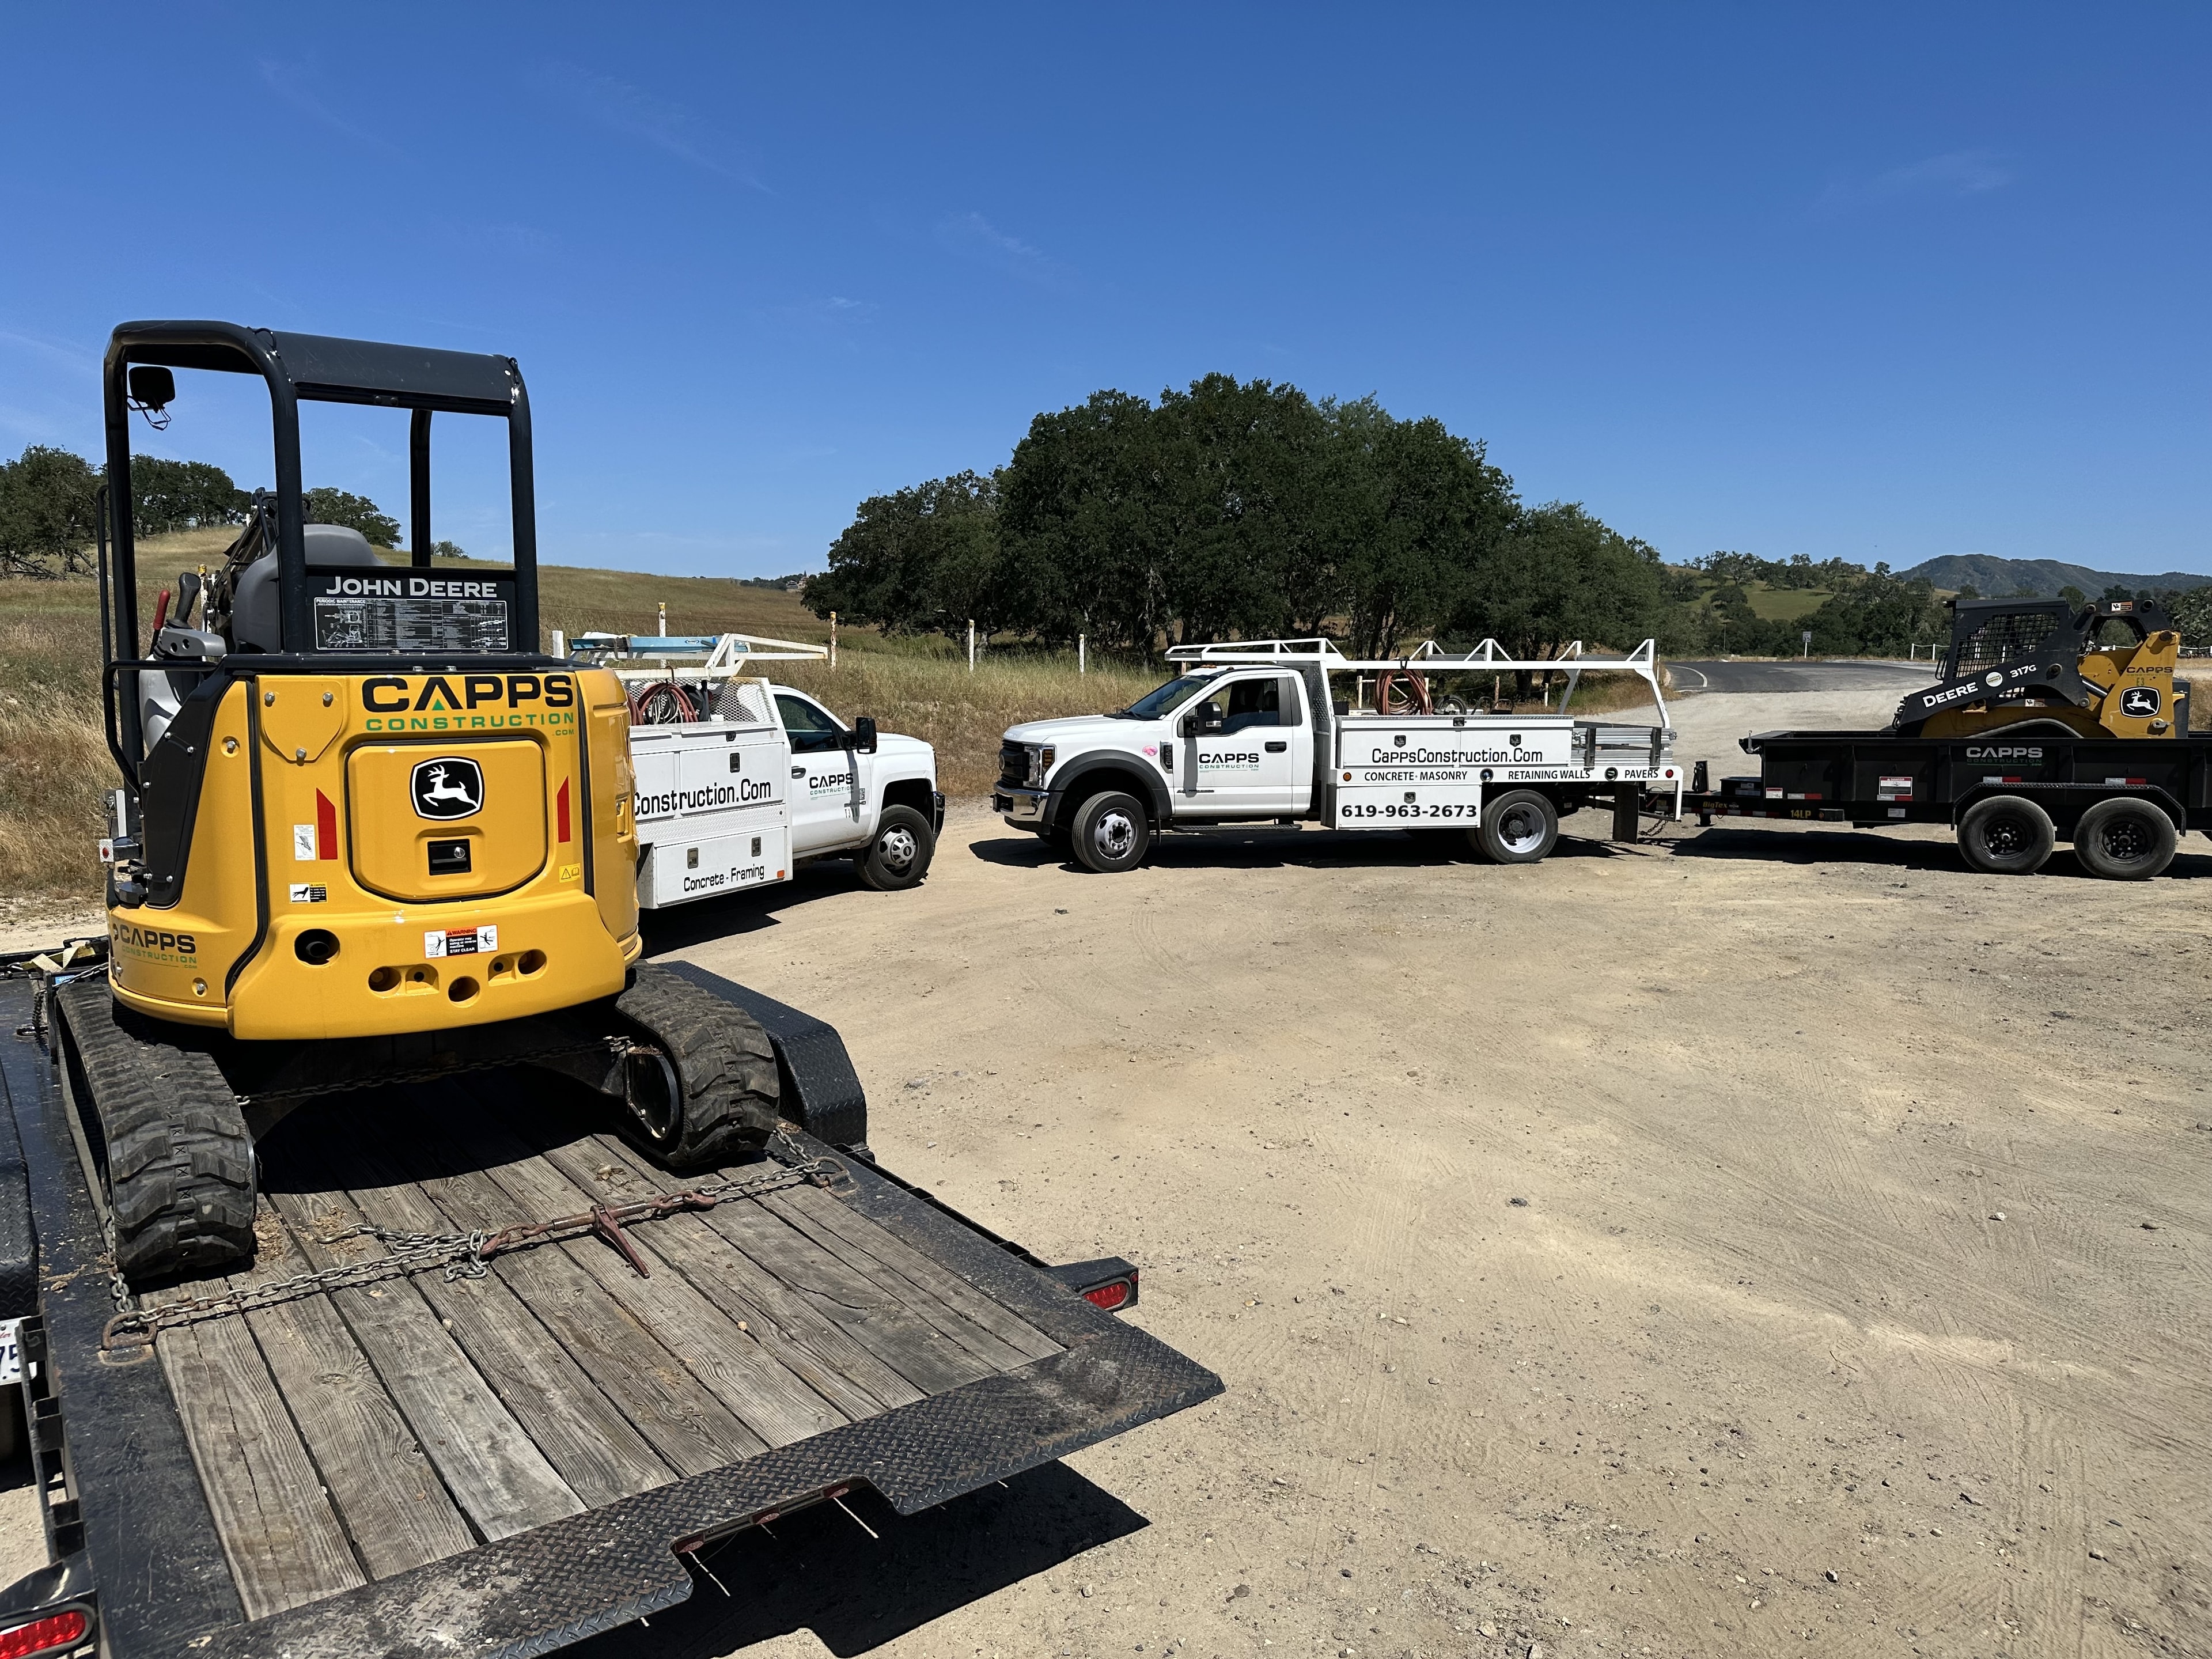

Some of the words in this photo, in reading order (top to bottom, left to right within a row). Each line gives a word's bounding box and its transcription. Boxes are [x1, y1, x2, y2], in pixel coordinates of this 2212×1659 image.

[326, 576, 402, 596] JOHN
[409, 578, 497, 598] DEERE
[2010, 664, 2037, 678] 317G
[362, 675, 573, 713] CAPPS
[1923, 682, 1978, 707] DEERE
[366, 713, 574, 731] CONSTRUCTION
[1199, 753, 1259, 763] CAPPS
[1966, 747, 2043, 757] CAPPS
[809, 773, 854, 789] CAPPS
[1364, 771, 1414, 781] CONCRETE
[1420, 771, 1468, 781] MASONRY
[1508, 770, 1558, 779] RETAINING
[1560, 770, 1590, 779] WALLS
[1624, 770, 1658, 778] PAVERS
[810, 785, 854, 795] CONSTRUCTION
[1342, 805, 1477, 817] 619-963-2673
[1791, 809, 1811, 818] 14LP
[684, 873, 724, 892] Concrete
[731, 863, 764, 882] Framing
[120, 924, 196, 954] CAPPS
[122, 945, 197, 964] CONSTRUCTION
